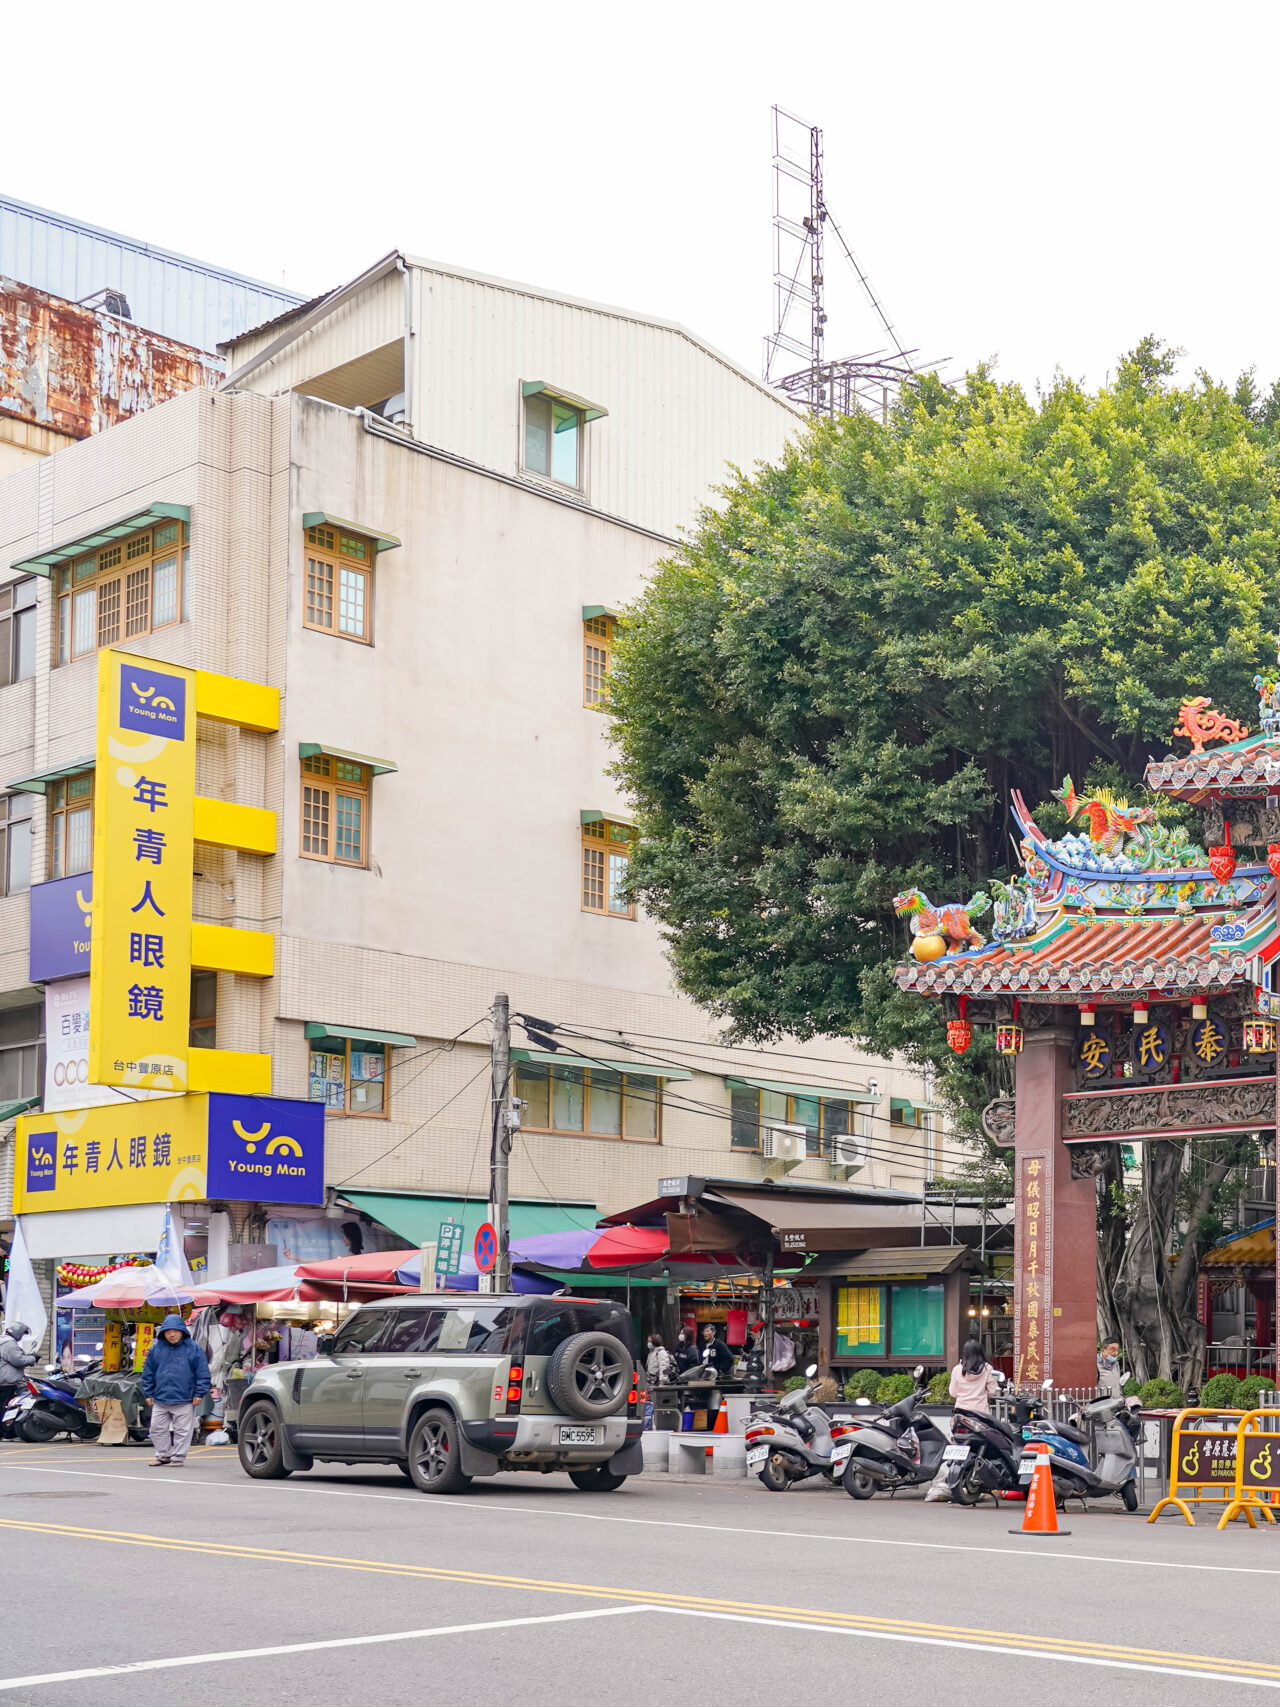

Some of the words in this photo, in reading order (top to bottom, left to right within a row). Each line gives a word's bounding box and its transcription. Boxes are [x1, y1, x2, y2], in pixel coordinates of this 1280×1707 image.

[128, 705, 156, 719] Young
[158, 712, 177, 722] Man
[127, 775, 169, 1022] 年青人眼鏡
[73, 940, 90, 953] You
[1139, 1025, 1164, 1066] 民
[1194, 1019, 1224, 1063] 泰
[1080, 1032, 1109, 1071] 安
[113, 1058, 175, 1077] 台中豐原店
[62, 1131, 172, 1177] 年青人眼鏡
[229, 1160, 272, 1177] Young
[276, 1163, 306, 1177] Man
[442, 1226, 452, 1237] P
[1025, 1159, 1041, 1381] 母儀昭日月千秋國泰民安
[1202, 1438, 1237, 1458] 豐原慈濟
[1211, 1469, 1217, 1477] NO
